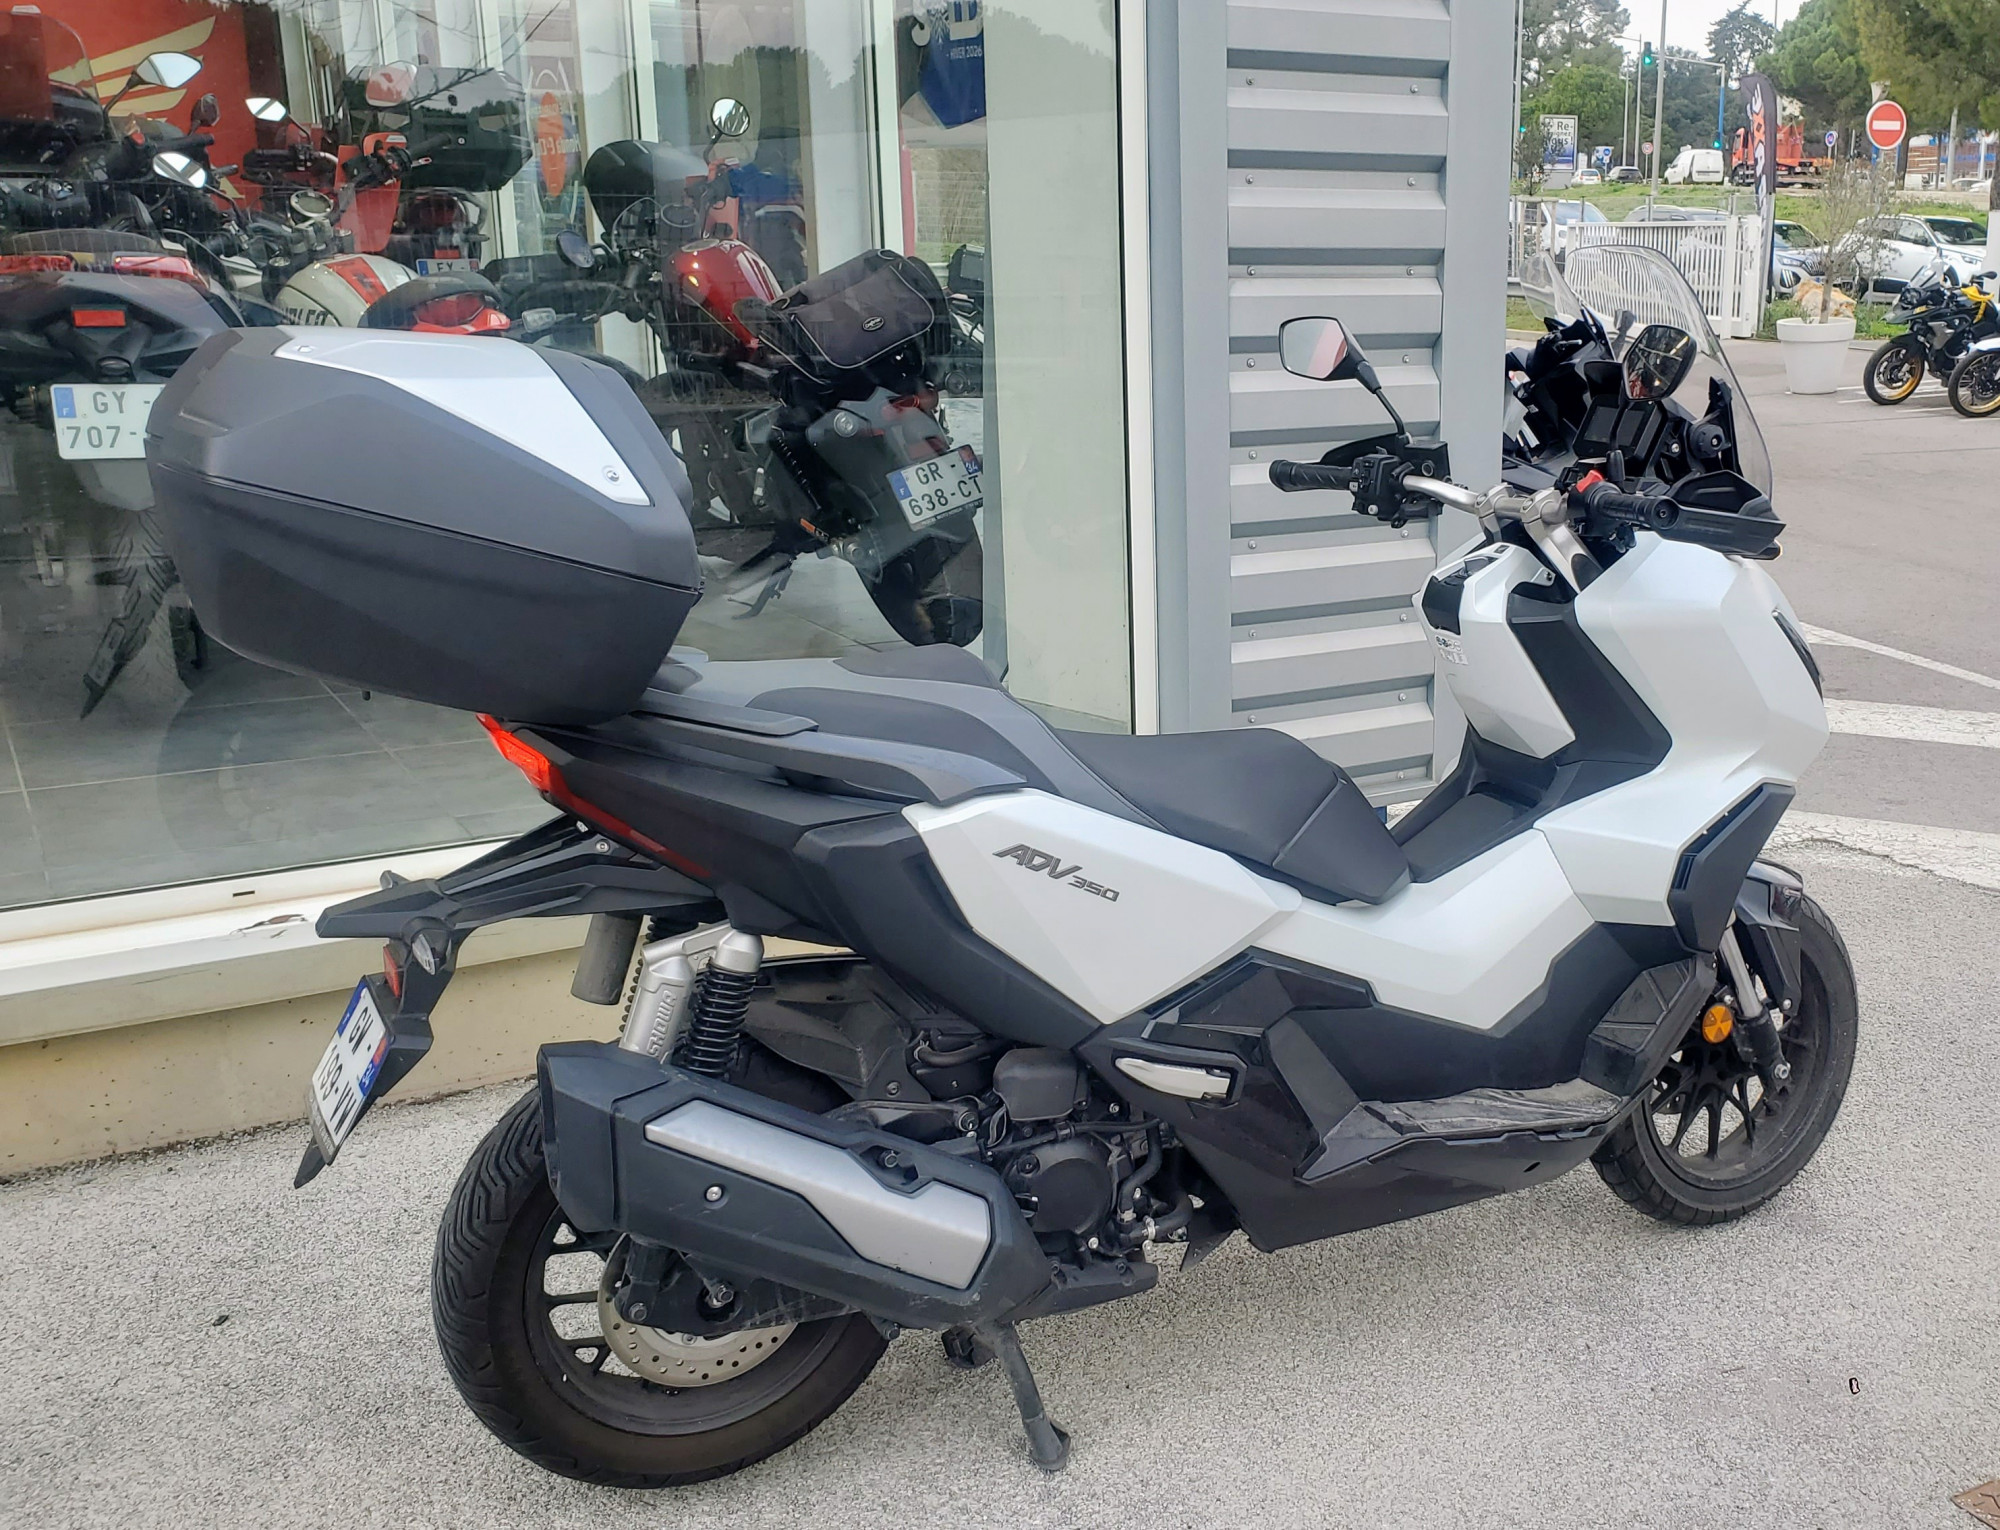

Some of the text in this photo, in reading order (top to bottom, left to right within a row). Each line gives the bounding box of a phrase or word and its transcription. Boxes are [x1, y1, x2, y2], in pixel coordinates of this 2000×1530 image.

[92, 391, 126, 414] GY
[915, 462, 944, 485] GR
[908, 475, 983, 517] 638-CT
[992, 843, 1120, 902] ADV 350
[647, 989, 677, 1058] SHOWA
